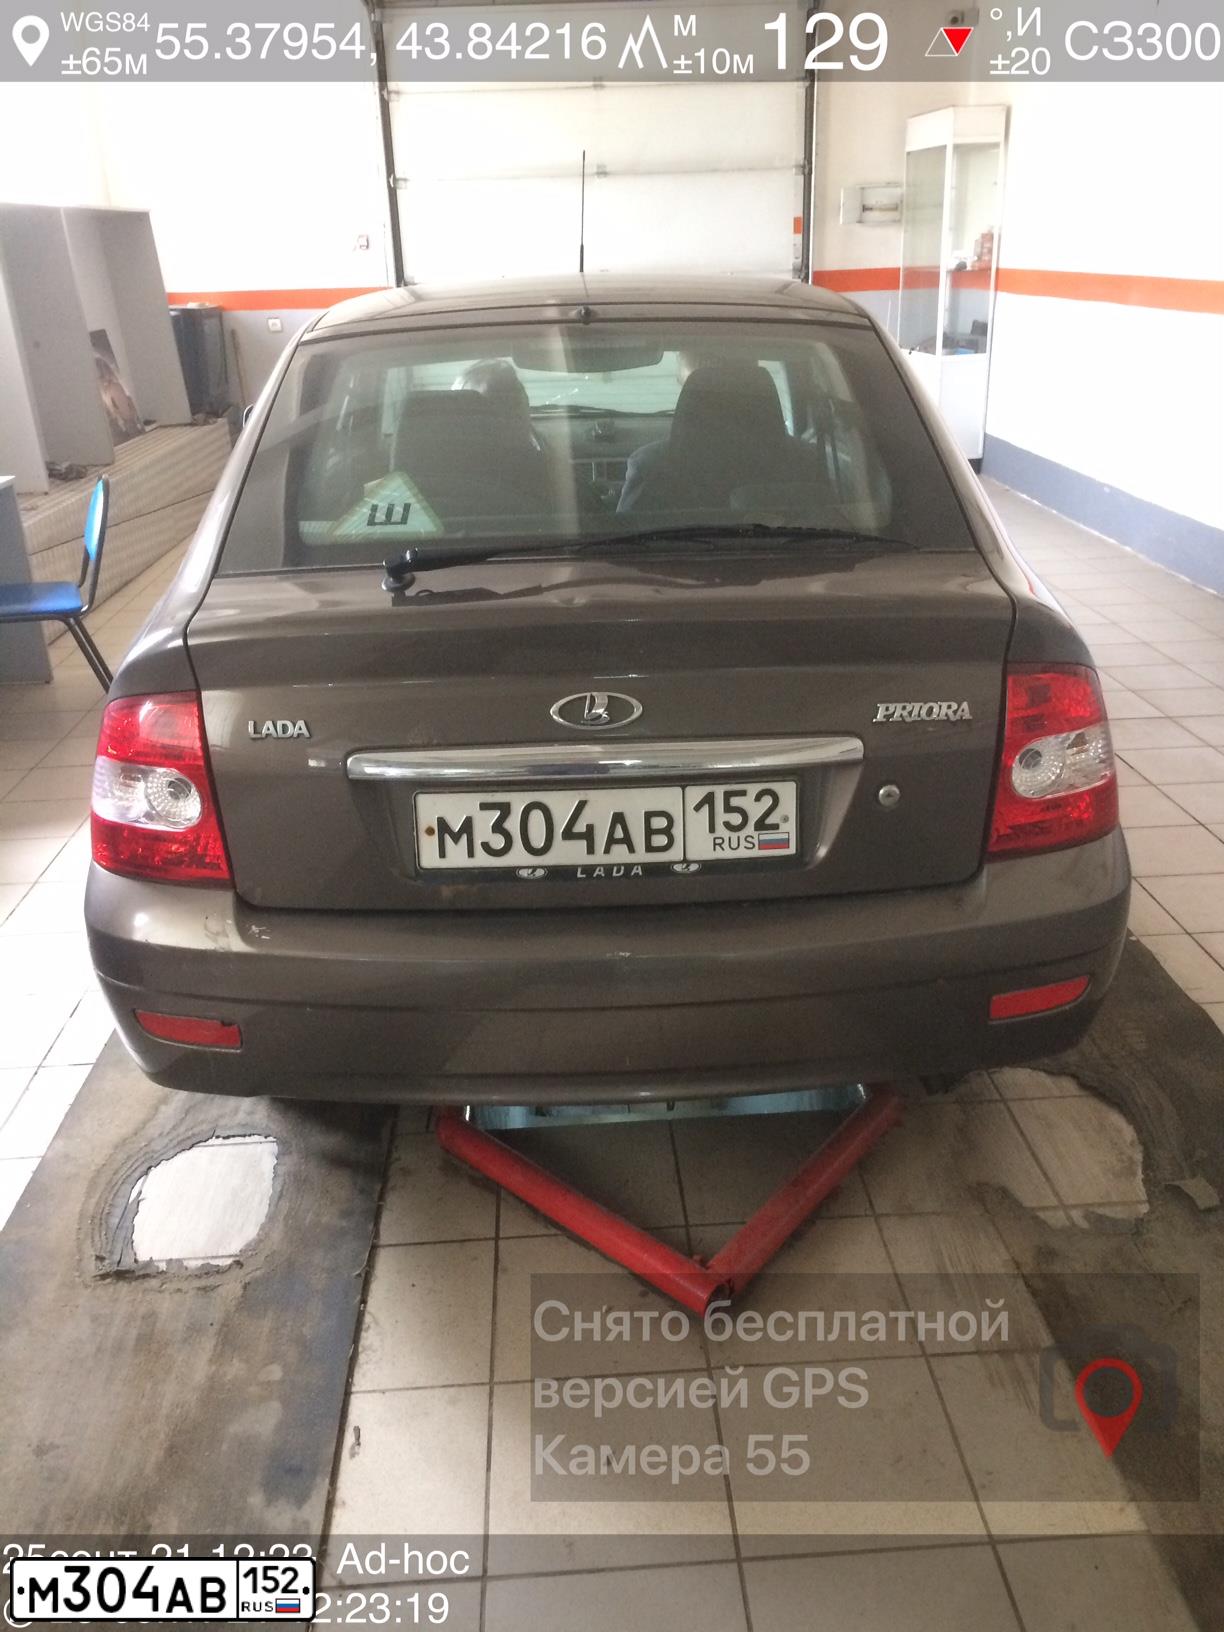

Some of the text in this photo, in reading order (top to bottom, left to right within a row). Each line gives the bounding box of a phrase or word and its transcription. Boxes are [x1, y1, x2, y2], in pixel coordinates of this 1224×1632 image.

[872, 700, 973, 723] PRIORA
[248, 719, 311, 739] LADA
[692, 787, 782, 835] 152
[712, 834, 757, 853] RUS
[576, 864, 643, 879] LADA
